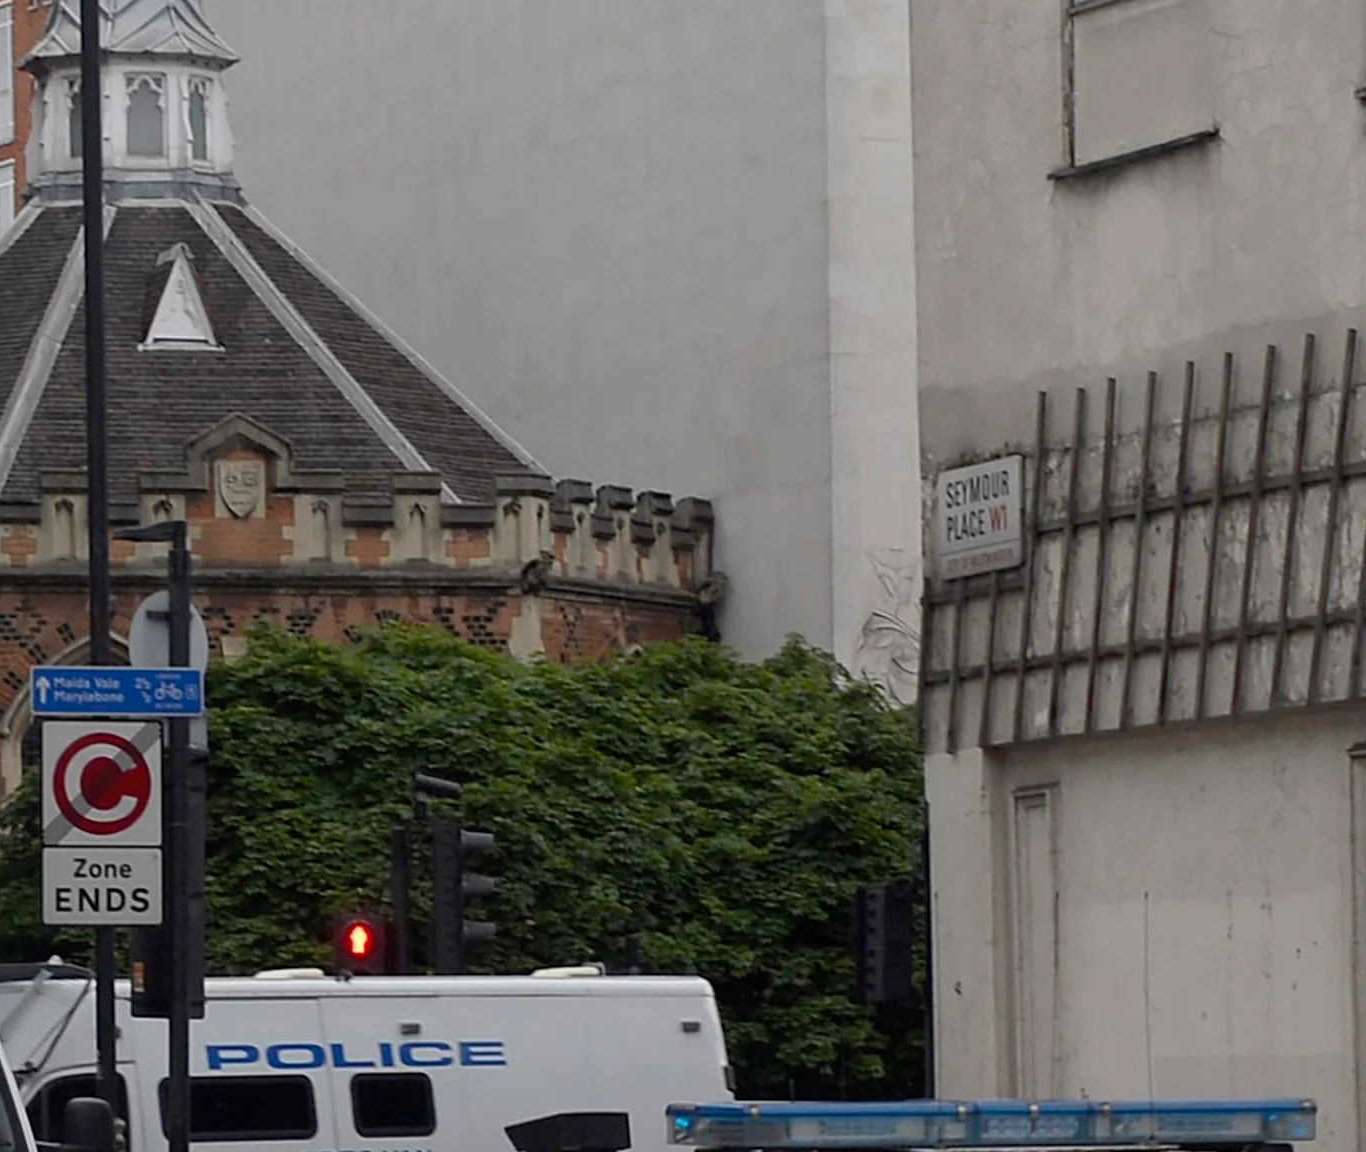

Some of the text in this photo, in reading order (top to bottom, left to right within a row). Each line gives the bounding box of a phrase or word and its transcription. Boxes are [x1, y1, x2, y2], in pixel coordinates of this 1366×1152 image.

[946, 470, 1010, 509] SEYMOUR
[946, 505, 1008, 543] PLACE W1
[53, 676, 91, 689] Maida
[94, 676, 121, 689] Vale
[53, 690, 125, 705] Marylebone
[73, 858, 133, 878] Zone
[55, 888, 150, 913] ENDS
[205, 1040, 508, 1071] POLICE
